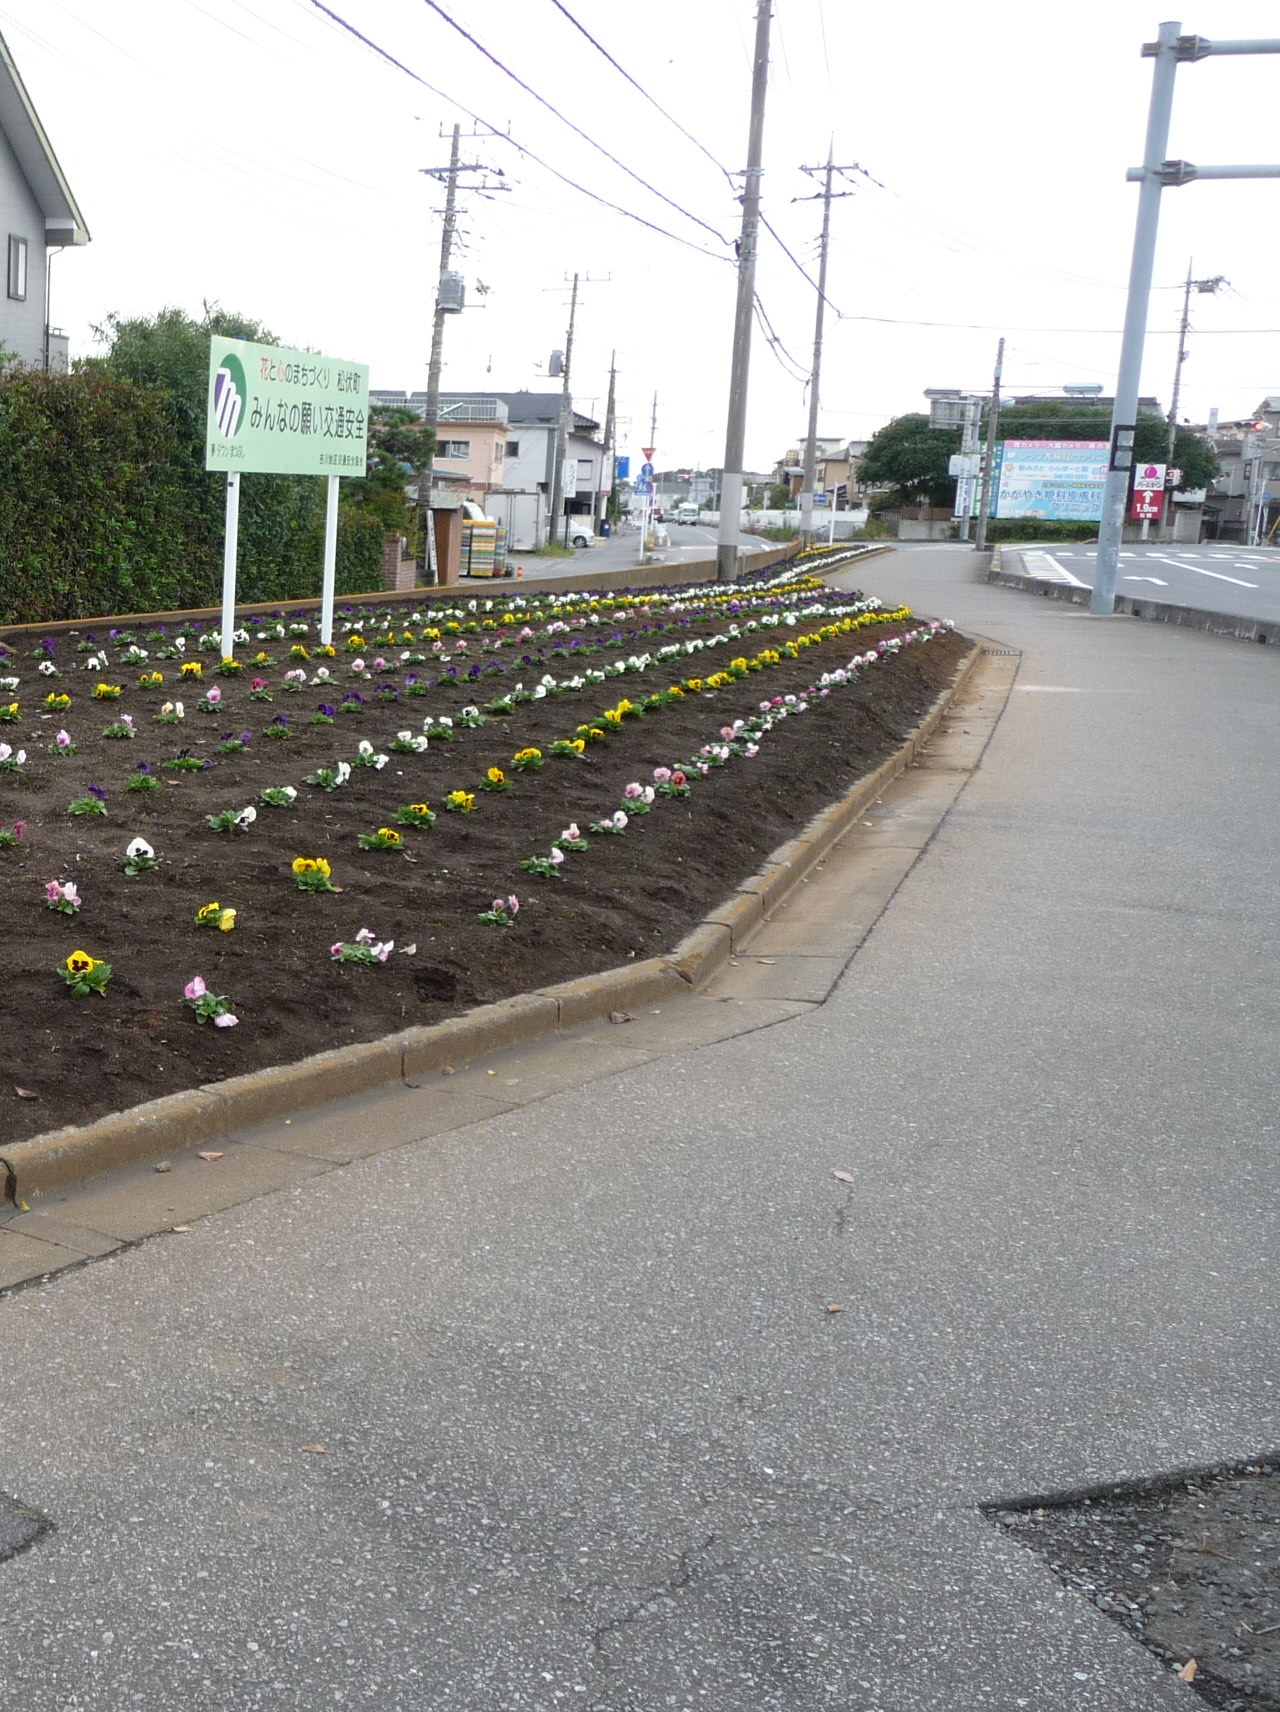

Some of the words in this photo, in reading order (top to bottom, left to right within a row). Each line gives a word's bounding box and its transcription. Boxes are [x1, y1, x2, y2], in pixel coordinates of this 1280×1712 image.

[260, 356, 330, 389] 花と心のまちづくり
[336, 368, 361, 394] 松伏町
[250, 396, 365, 439] みんなの願い交通安全
[1052, 502, 1101, 512] クリニック
